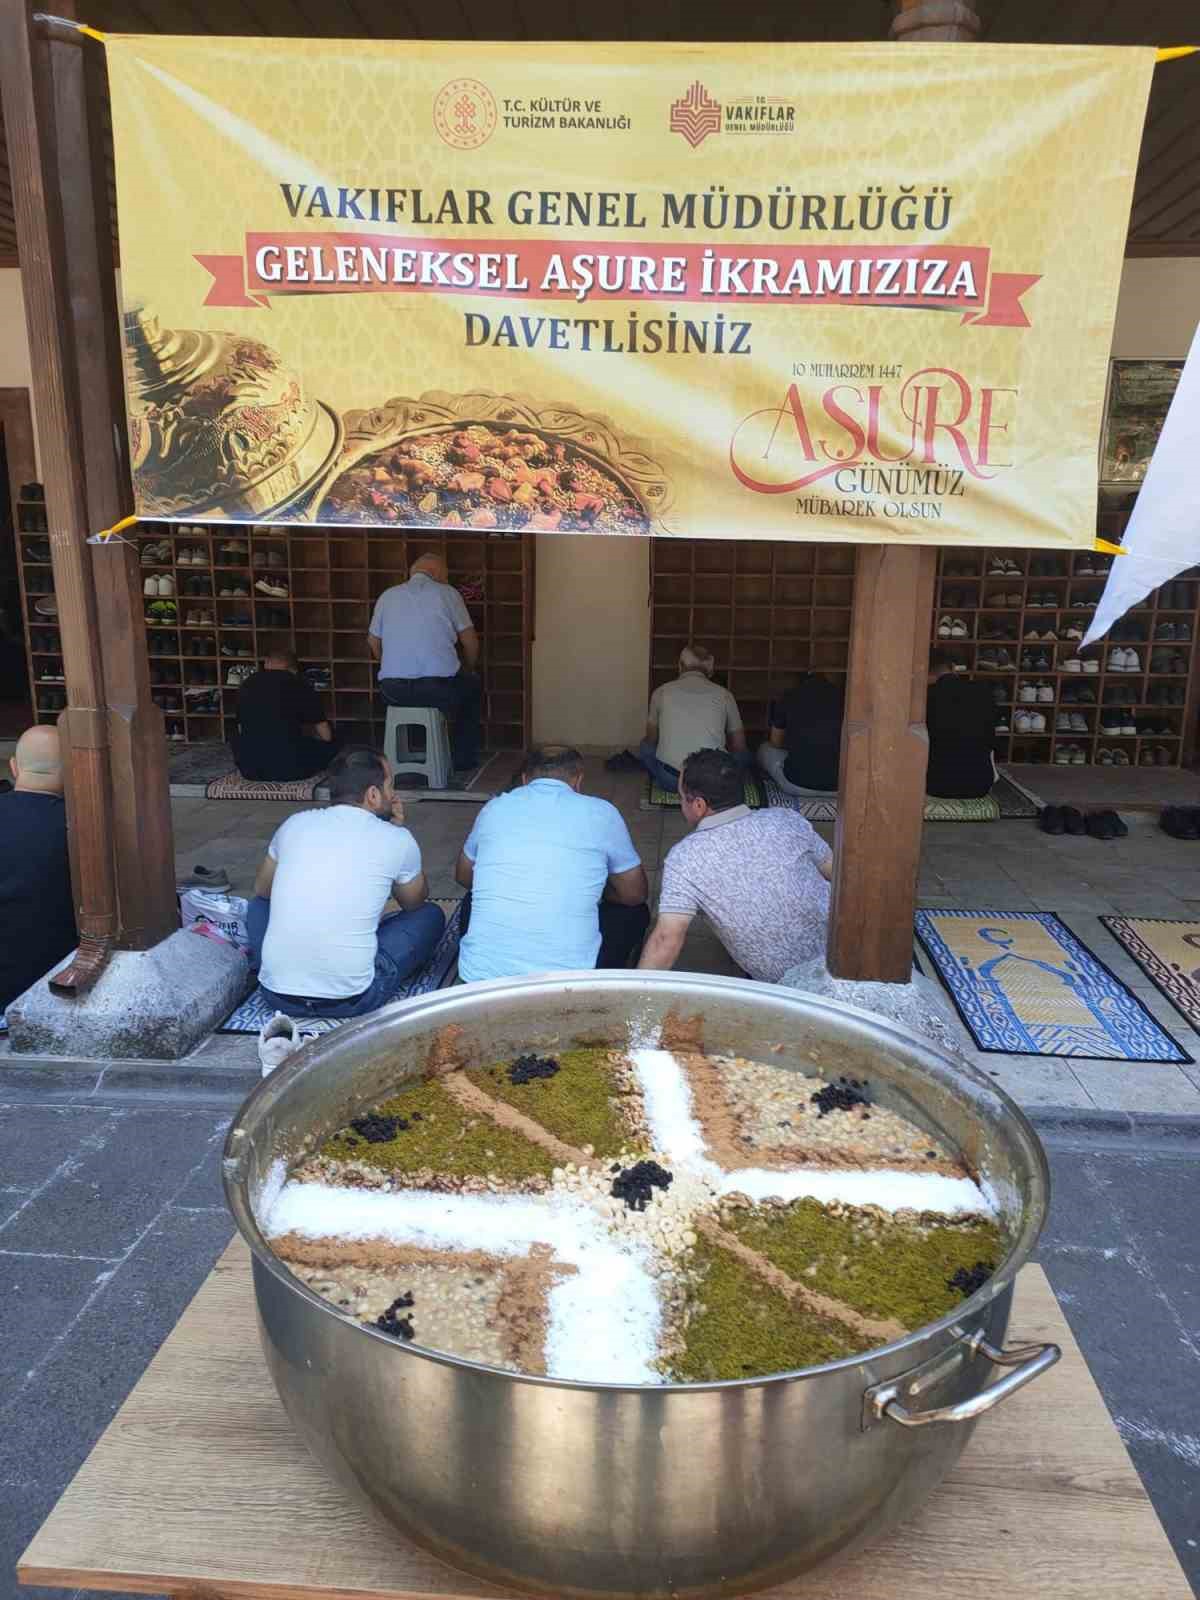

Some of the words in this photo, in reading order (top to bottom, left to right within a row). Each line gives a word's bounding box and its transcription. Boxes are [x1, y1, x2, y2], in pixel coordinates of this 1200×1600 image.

[504, 100, 526, 112] T.C.
[530, 97, 581, 113] KÜLTÜR
[584, 100, 602, 113] VE
[725, 105, 796, 121] VAKIFLAR
[503, 114, 555, 129] TURİZM
[559, 115, 632, 130] BAKANLIĞI
[280, 183, 494, 226] VAKIFLAR
[507, 189, 647, 228] GENEL
[660, 184, 953, 231] MÜDÜRLÜĞÜ
[255, 245, 529, 291] GELENEKSEL
[539, 253, 687, 302] AŞURE
[699, 248, 979, 297] İKRAMIZIZA
[464, 311, 753, 355] DAVETLİSİNİZ
[809, 363, 875, 379] MUHARREM
[879, 365, 903, 378] 1447
[834, 462, 966, 497] GÜNÜMÜZ
[795, 495, 877, 518] MÜBAREK
[882, 501, 943, 519] OLSUN
